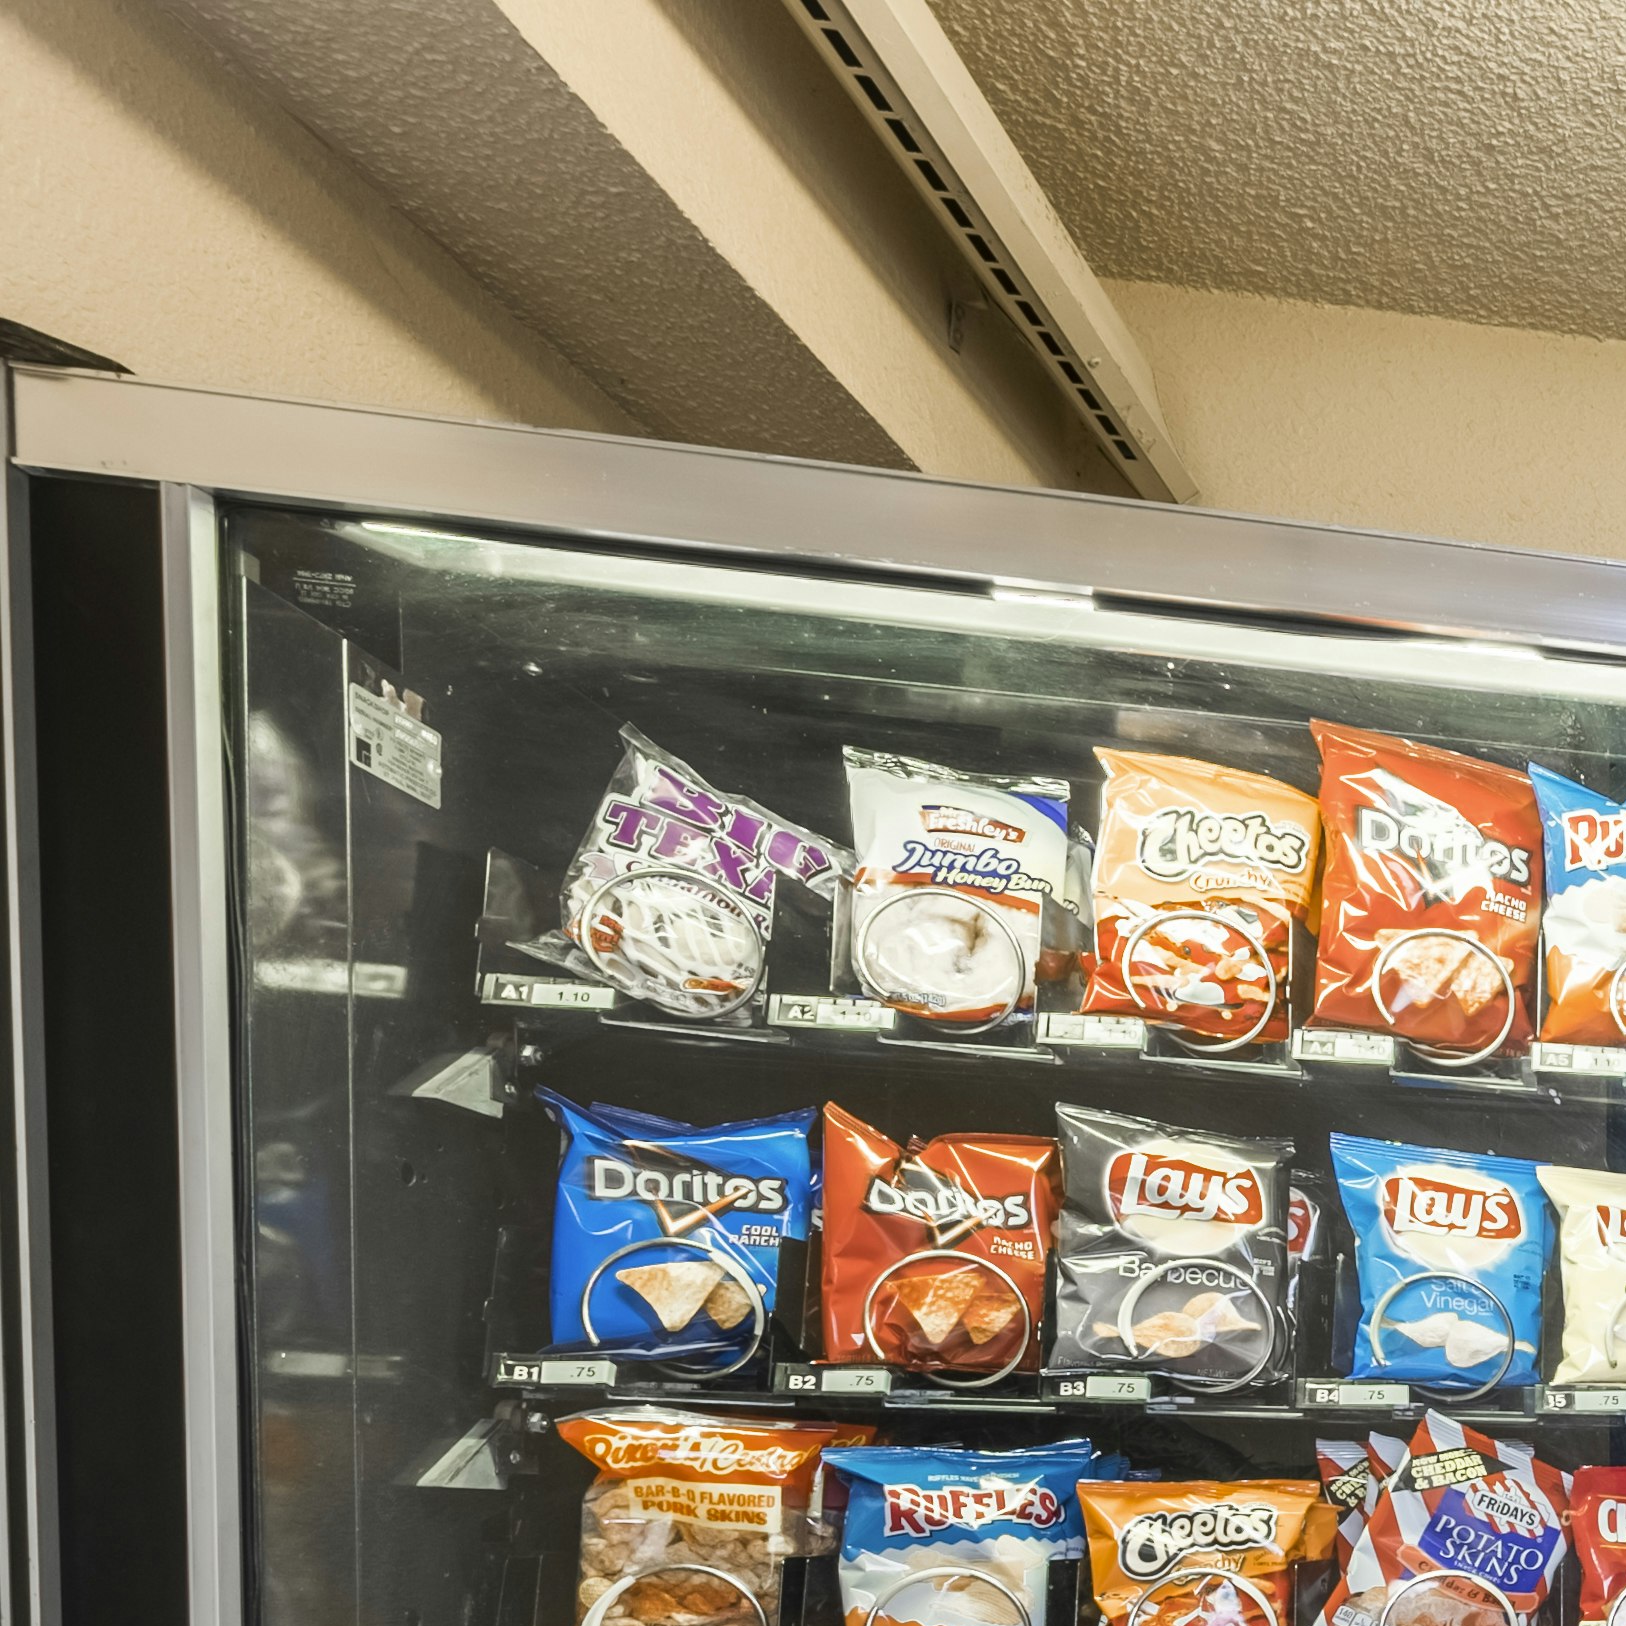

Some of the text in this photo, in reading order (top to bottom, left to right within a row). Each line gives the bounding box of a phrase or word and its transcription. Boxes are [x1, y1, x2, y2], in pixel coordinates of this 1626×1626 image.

[645, 764, 832, 884] BIG
[929, 813, 1019, 841] Freshley's
[606, 800, 775, 901] TEXA
[892, 840, 1021, 876] Jumbo
[1140, 808, 1308, 882] Cheetos
[932, 867, 1053, 895] Honey Bun
[1481, 900, 1527, 922] CHEESE
[556, 991, 591, 1004] 1.10
[591, 1157, 786, 1210] Doritos
[1121, 1152, 1253, 1222] Lay's
[866, 1176, 1032, 1228] Doritos
[729, 1233, 781, 1248] RANCH
[741, 1224, 779, 1237] COOL
[1420, 1291, 1497, 1316] Vinegar
[513, 1366, 597, 1382] B1 .75
[788, 1375, 875, 1391] B2 .75
[1059, 1382, 1136, 1396] B3 .75
[1315, 1389, 1338, 1402] B4
[1410, 1454, 1483, 1479] CHEDDAR
[1414, 1464, 1488, 1490] & BACON
[634, 1484, 776, 1509] BAR-B-Q FLAVORED
[884, 1485, 1066, 1536] RUFFLES
[642, 1499, 768, 1527] PORK SKINS
[1118, 1502, 1278, 1580] Cheetos
[1434, 1514, 1544, 1572] POTATO
[1439, 1536, 1523, 1586] SKINS
